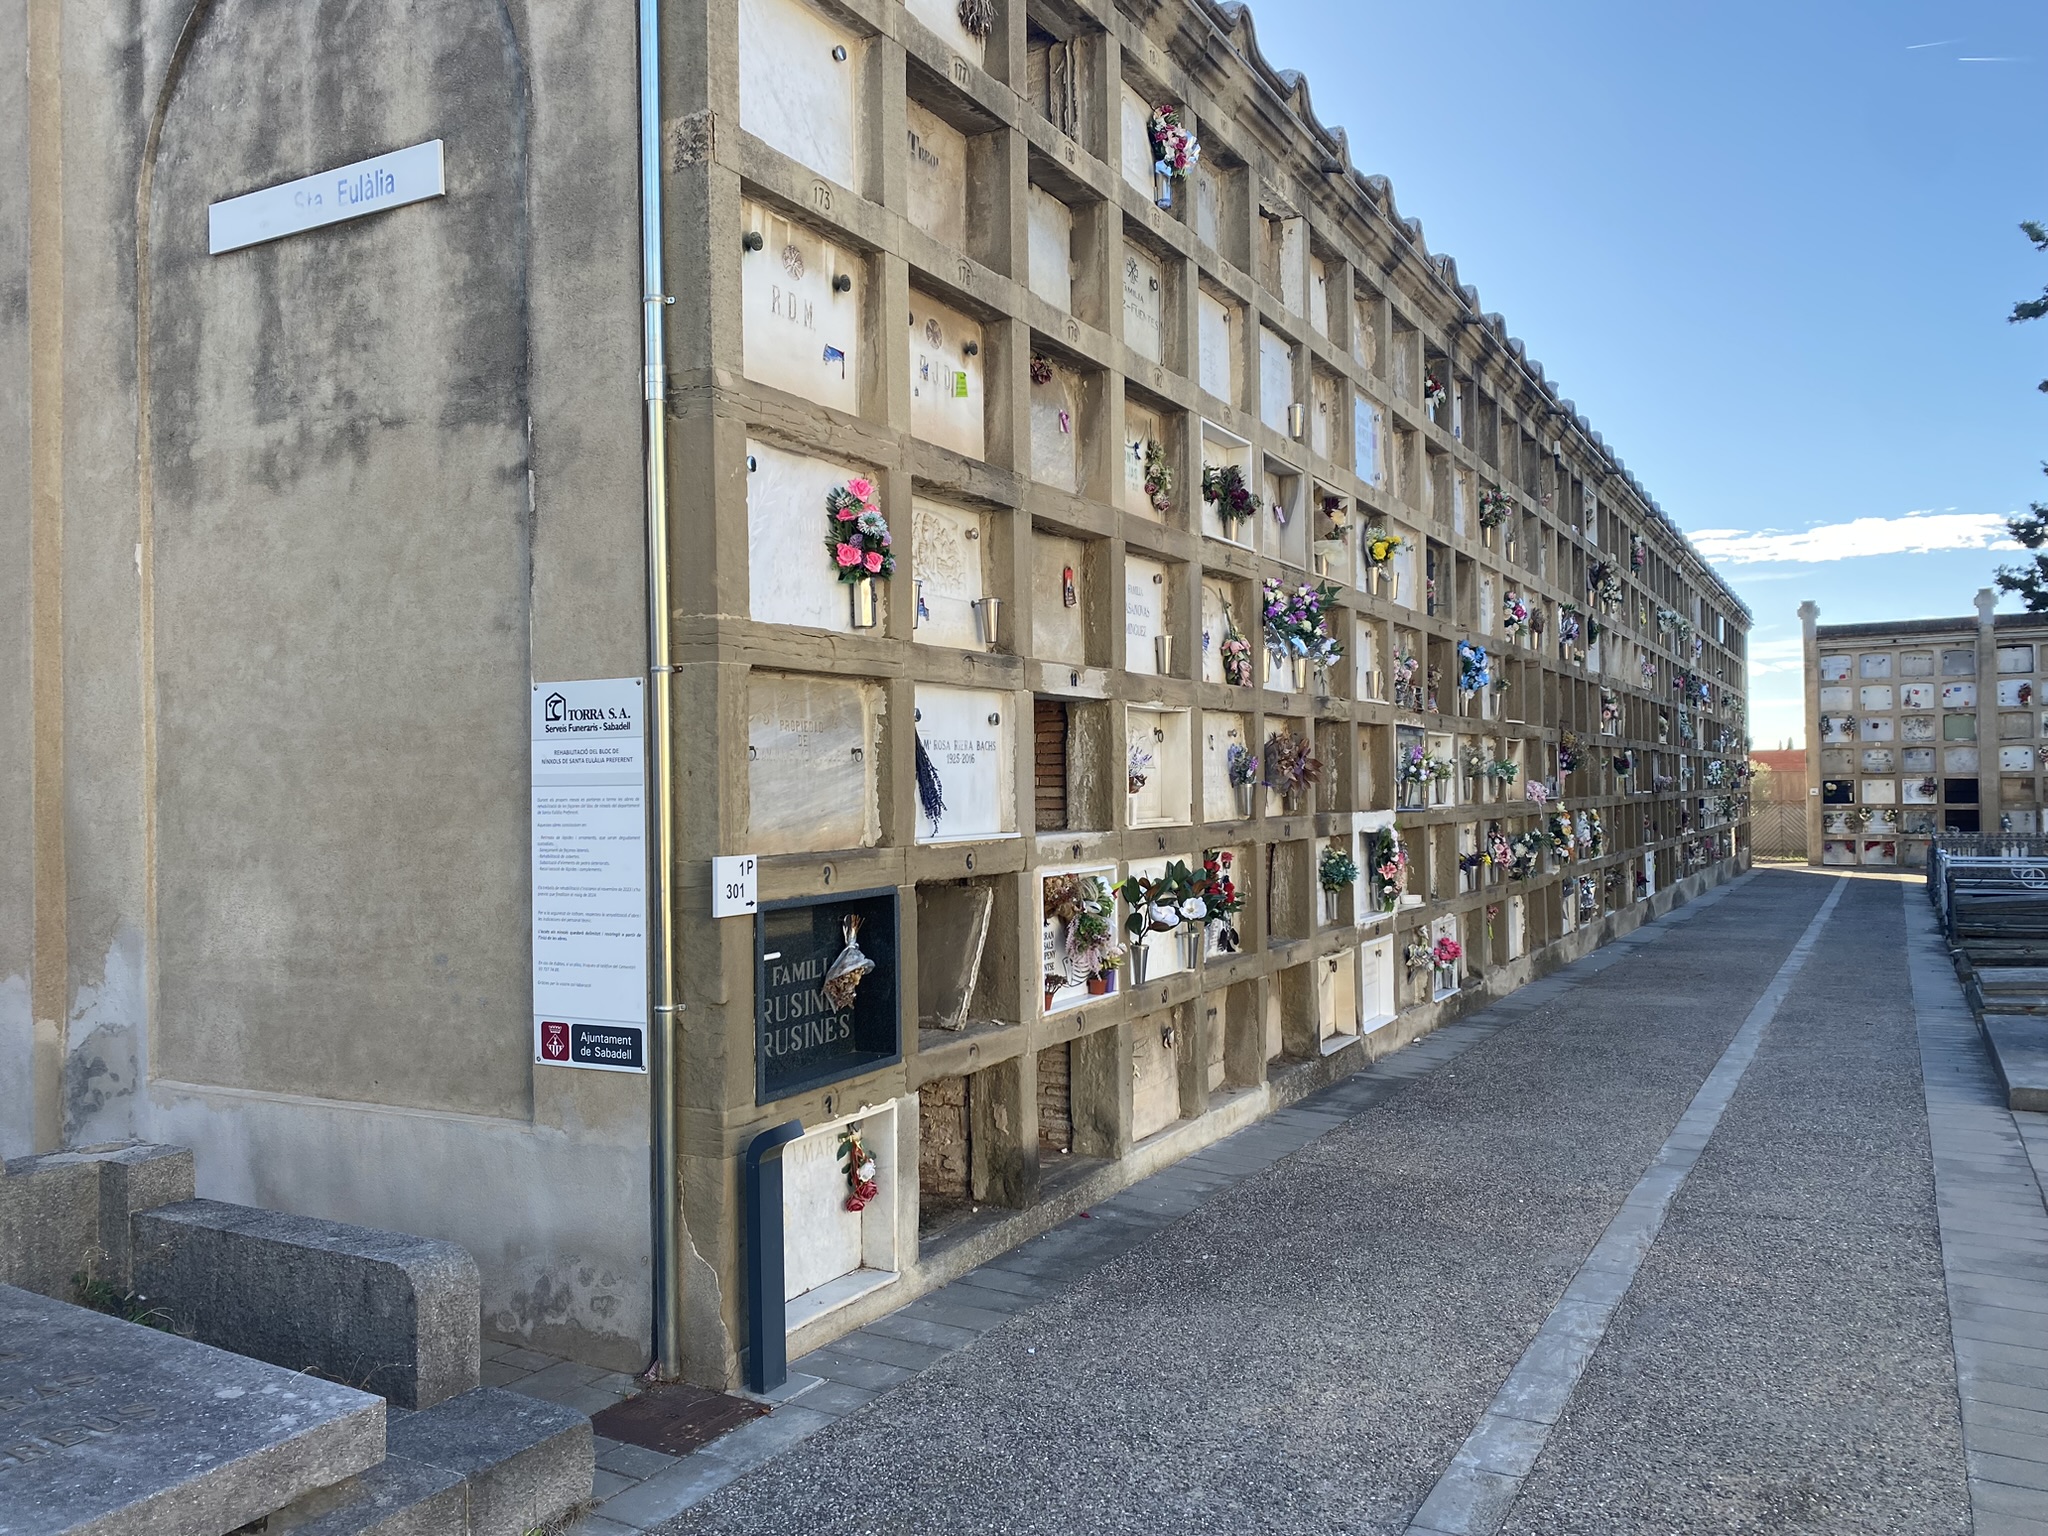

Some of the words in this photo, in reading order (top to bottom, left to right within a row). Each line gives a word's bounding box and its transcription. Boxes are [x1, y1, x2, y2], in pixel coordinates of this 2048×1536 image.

[954, 62, 967, 84] 177
[337, 168, 395, 207] Eulàlia
[814, 186, 831, 210] 173
[568, 708, 605, 722] TORRA
[545, 723, 567, 733] Serveis
[568, 722, 598, 733] Funeraris
[603, 722, 631, 731] Sabadell
[934, 739, 951, 751] ROSA
[976, 740, 997, 751] BACHS
[965, 852, 973, 870] 6
[726, 882, 745, 900] 301
[772, 957, 828, 987] FAMILI
[764, 988, 833, 1024] RUSIN
[580, 1031, 632, 1047] Ajuntament
[764, 1013, 851, 1058] RUSINES
[580, 1045, 592, 1056] de
[594, 1046, 632, 1060] Sabadell
[824, 1095, 833, 1114] 1
